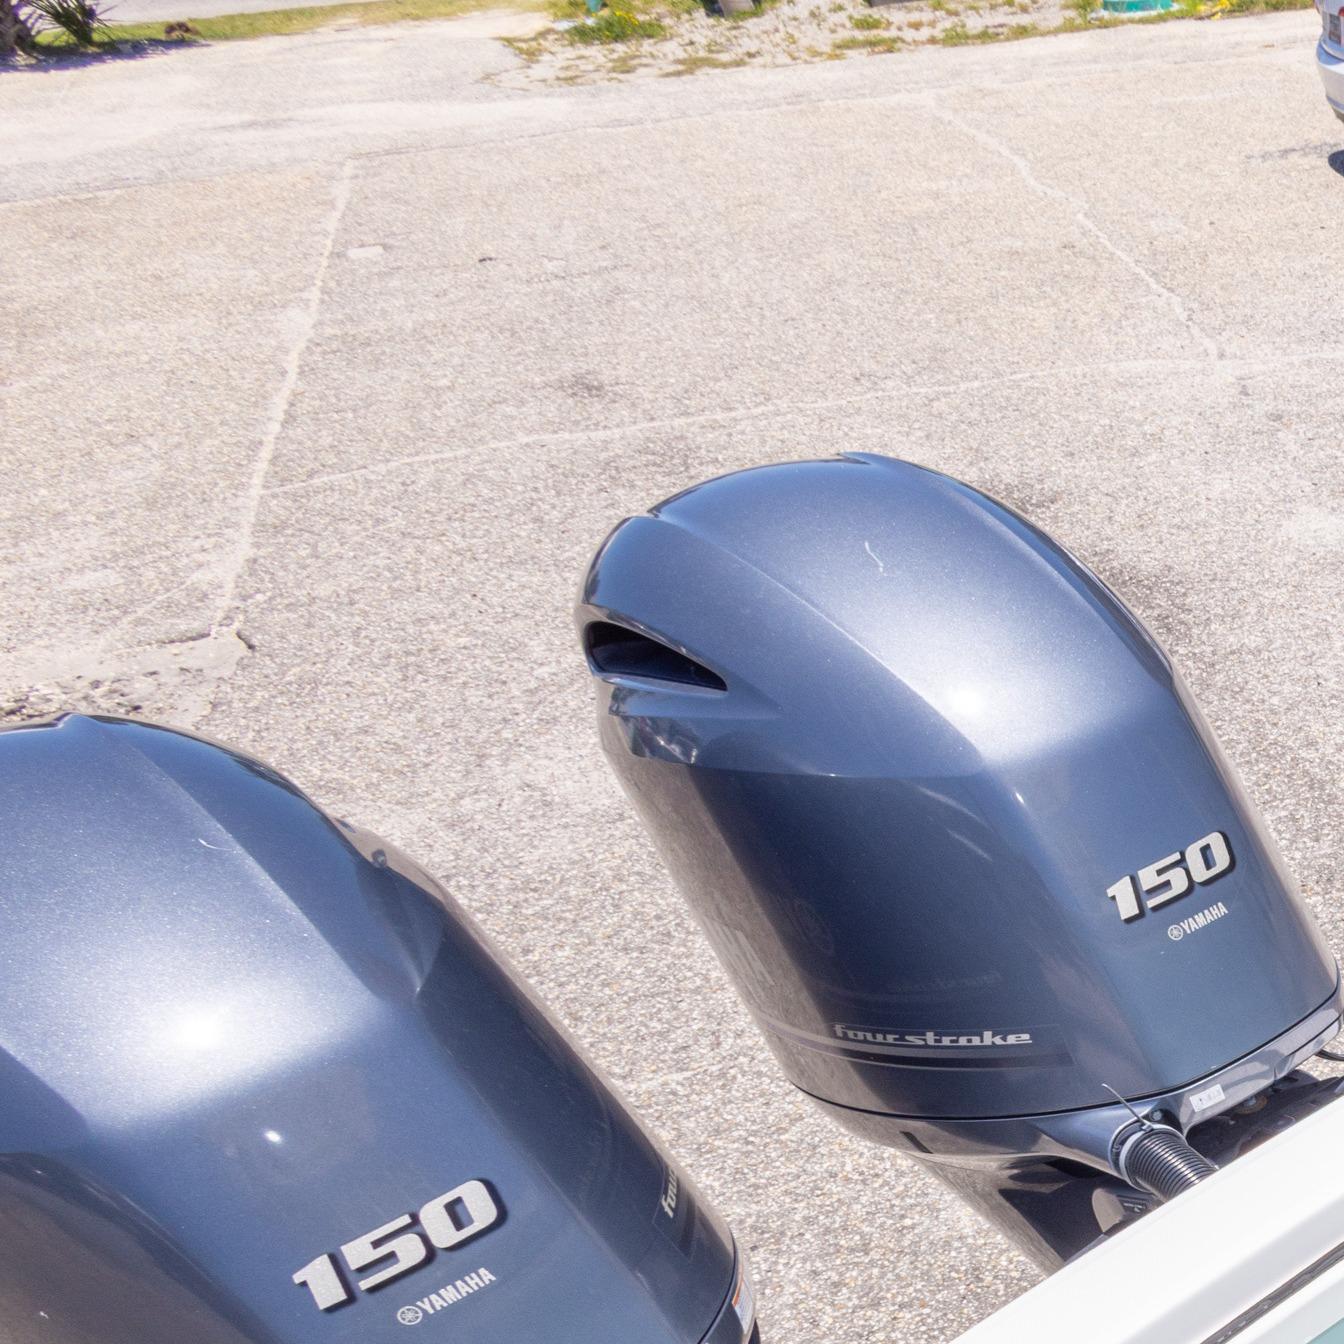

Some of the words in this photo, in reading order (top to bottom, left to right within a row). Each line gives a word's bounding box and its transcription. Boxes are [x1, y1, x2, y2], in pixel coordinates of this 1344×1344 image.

[1106, 831, 1231, 921] 150
[1180, 901, 1229, 934] YAMAHA
[833, 1024, 903, 1045] four
[904, 1031, 1033, 1046] stroke
[291, 1179, 499, 1311] 150
[416, 1267, 497, 1305] YAMAHA
